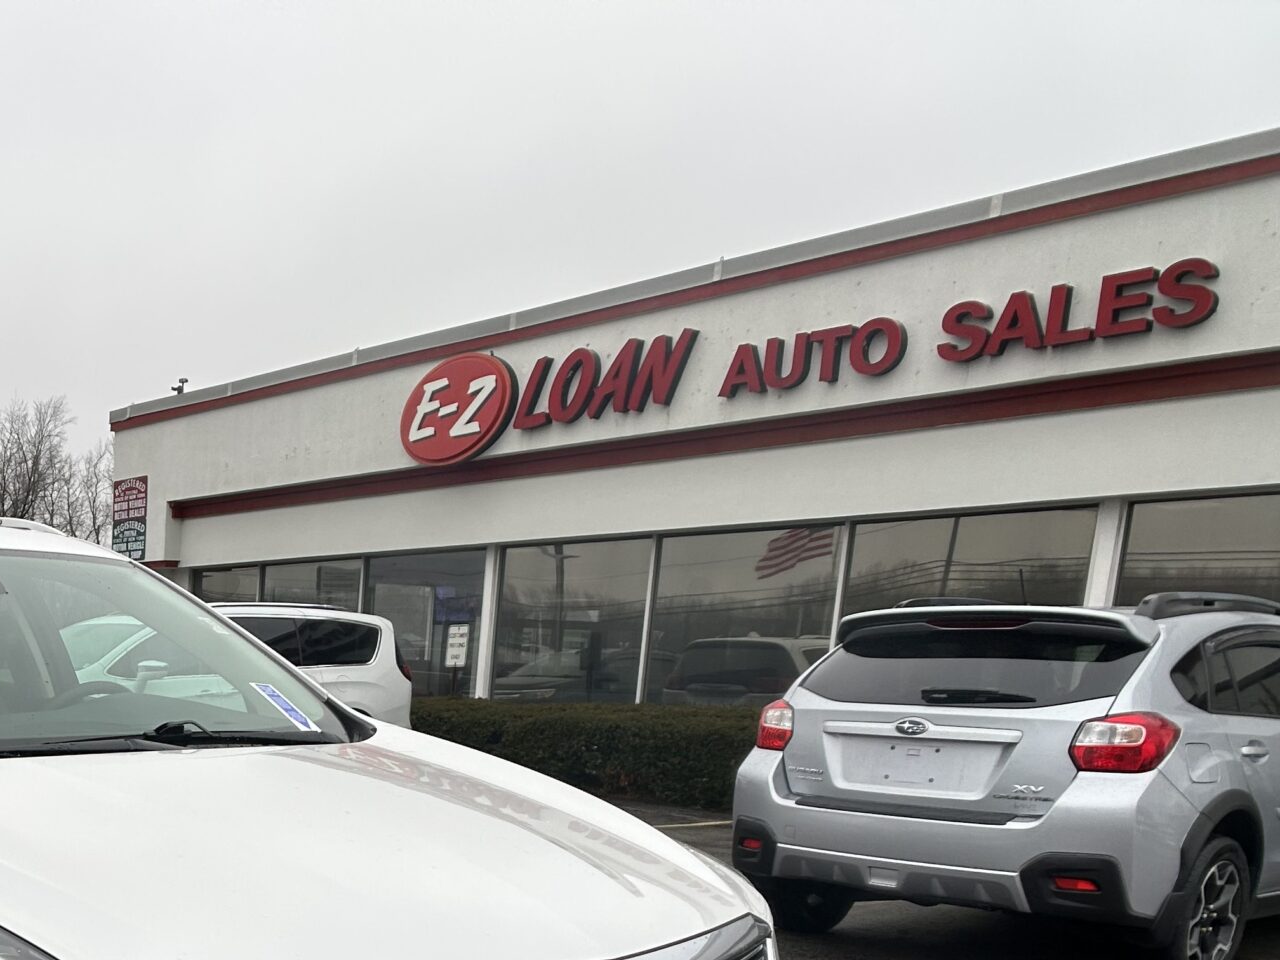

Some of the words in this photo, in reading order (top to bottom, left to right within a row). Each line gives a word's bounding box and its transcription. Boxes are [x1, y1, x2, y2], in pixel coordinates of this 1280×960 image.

[408, 374, 497, 442] E-Z
[513, 328, 701, 431] LOAN
[717, 316, 908, 398] AUTO
[936, 257, 1220, 364] SALES
[115, 479, 146, 496] REGISTERED
[129, 508, 144, 517] DEALER
[114, 521, 145, 536] REGISTERED
[1012, 784, 1045, 793] XV
